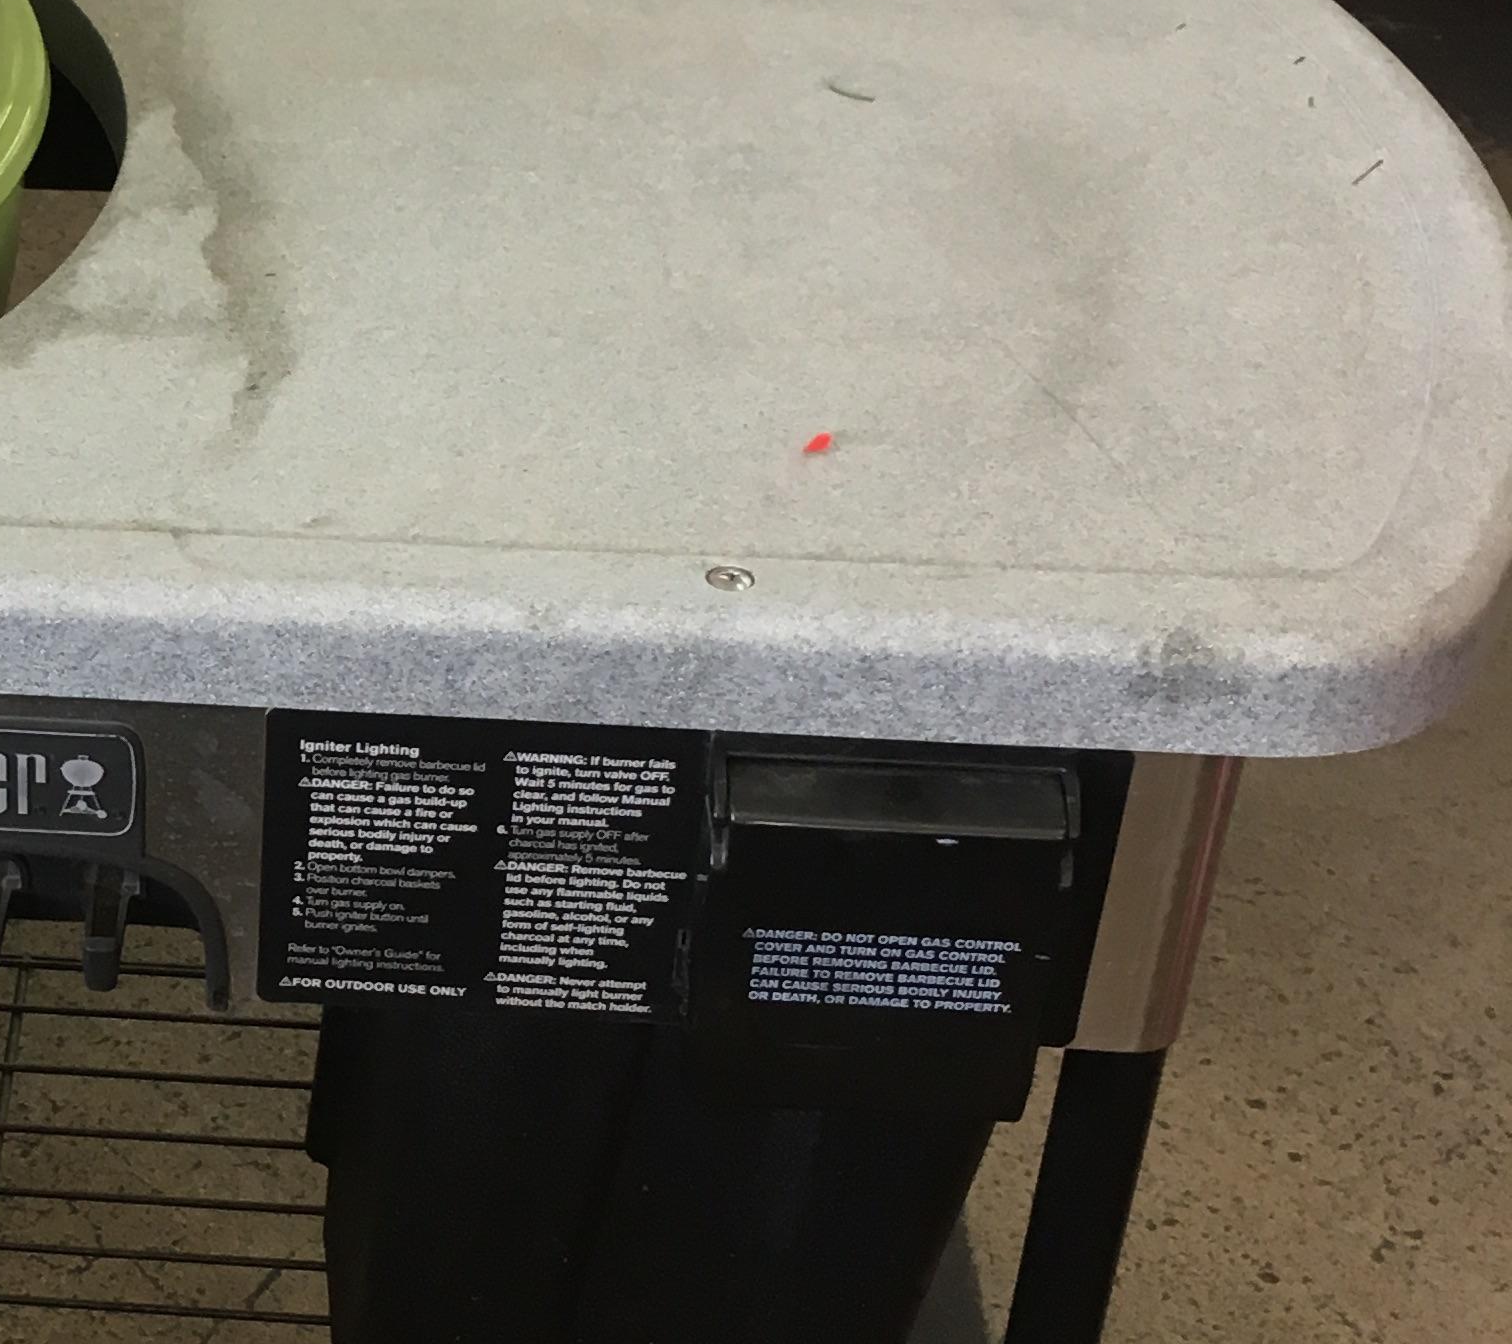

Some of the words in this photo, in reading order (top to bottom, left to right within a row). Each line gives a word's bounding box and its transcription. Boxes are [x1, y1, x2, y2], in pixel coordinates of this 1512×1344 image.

[300, 740, 351, 755] Igniter
[356, 742, 419, 757] Lighting
[590, 756, 600, 766] If
[603, 757, 646, 767] burner
[648, 759, 676, 769] fails
[516, 765, 529, 774] to
[574, 768, 601, 777] turn
[603, 770, 637, 779] valve
[375, 781, 419, 792] Failure
[422, 784, 436, 793] to
[438, 785, 455, 794] do
[514, 777, 545, 787] Wait
[547, 779, 555, 788] 5
[558, 781, 610, 790] minutes
[613, 782, 632, 791] for
[634, 785, 658, 794] gas
[661, 785, 675, 794] to
[310, 792, 334, 800] can
[336, 794, 374, 802] cause
[376, 795, 385, 803] a
[388, 796, 411, 805] gas
[414, 796, 467, 808] build-up
[551, 792, 576, 801] and
[578, 793, 619, 803] follow
[621, 795, 670, 805] Manual
[310, 803, 335, 812] that
[363, 807, 401, 815] cause
[415, 808, 436, 818] fire
[512, 802, 564, 814] Lighting
[566, 805, 642, 816] instructions
[309, 816, 370, 829] explosion
[373, 818, 411, 828] which
[439, 823, 477, 832] cause
[511, 814, 523, 822] in
[526, 816, 555, 825] your
[308, 828, 355, 837] serious
[358, 829, 396, 842] bodily
[398, 831, 434, 843] injury
[365, 842, 417, 853] damage
[420, 845, 433, 853] to
[571, 865, 624, 876] Remove
[626, 868, 687, 879] barbecue
[506, 873, 521, 882] lid
[524, 874, 566, 884] before
[622, 879, 641, 888] Do
[644, 882, 665, 890] not
[505, 886, 528, 894] use
[530, 888, 554, 897] any
[556, 888, 624, 899] flammable
[626, 892, 669, 902] liquids
[503, 898, 534, 906] such
[554, 900, 603, 911] starting
[502, 920, 531, 929] form
[534, 922, 548, 930] of
[550, 923, 624, 936] self-lighting
[630, 917, 654, 926] any
[500, 932, 555, 942] charcoal
[556, 935, 570, 943] at
[572, 937, 595, 947] any
[845, 934, 875, 943] NOT
[878, 935, 918, 945] OPEN
[920, 937, 951, 947] GAS
[954, 940, 1021, 951] CONTROL
[500, 943, 557, 957] including
[559, 946, 594, 955] when
[754, 942, 802, 952] COVER
[805, 945, 836, 953] AND
[839, 946, 877, 955] TURN
[904, 949, 935, 959] GAS
[938, 951, 1005, 962] CONTROL
[498, 956, 555, 966] manually
[752, 954, 809, 965] BEFORE
[812, 957, 887, 969] REMOVING
[890, 962, 968, 973] BARBECUE
[559, 977, 596, 986] Never
[598, 980, 646, 990] attempt
[751, 967, 808, 977] FAILURE
[834, 971, 894, 982] REMOVE
[897, 974, 974, 986] BARBECUE
[977, 978, 1000, 987] LID
[292, 978, 321, 987] FOR
[324, 980, 394, 991] OUTDOOR
[398, 984, 426, 994] USE
[430, 986, 466, 996] ONLY
[497, 984, 510, 993] to
[512, 987, 569, 998] manually
[571, 989, 599, 999] light
[601, 990, 643, 1000] burner
[750, 979, 779, 988] CAN
[782, 980, 828, 990] CAUSE
[832, 983, 894, 994] SERIOUS
[898, 986, 949, 997] BODILY
[952, 990, 1002, 999] INJURY
[495, 996, 542, 1006] without
[545, 999, 565, 1008] the
[567, 1002, 606, 1010] match
[848, 996, 909, 1007] DAMAGE
